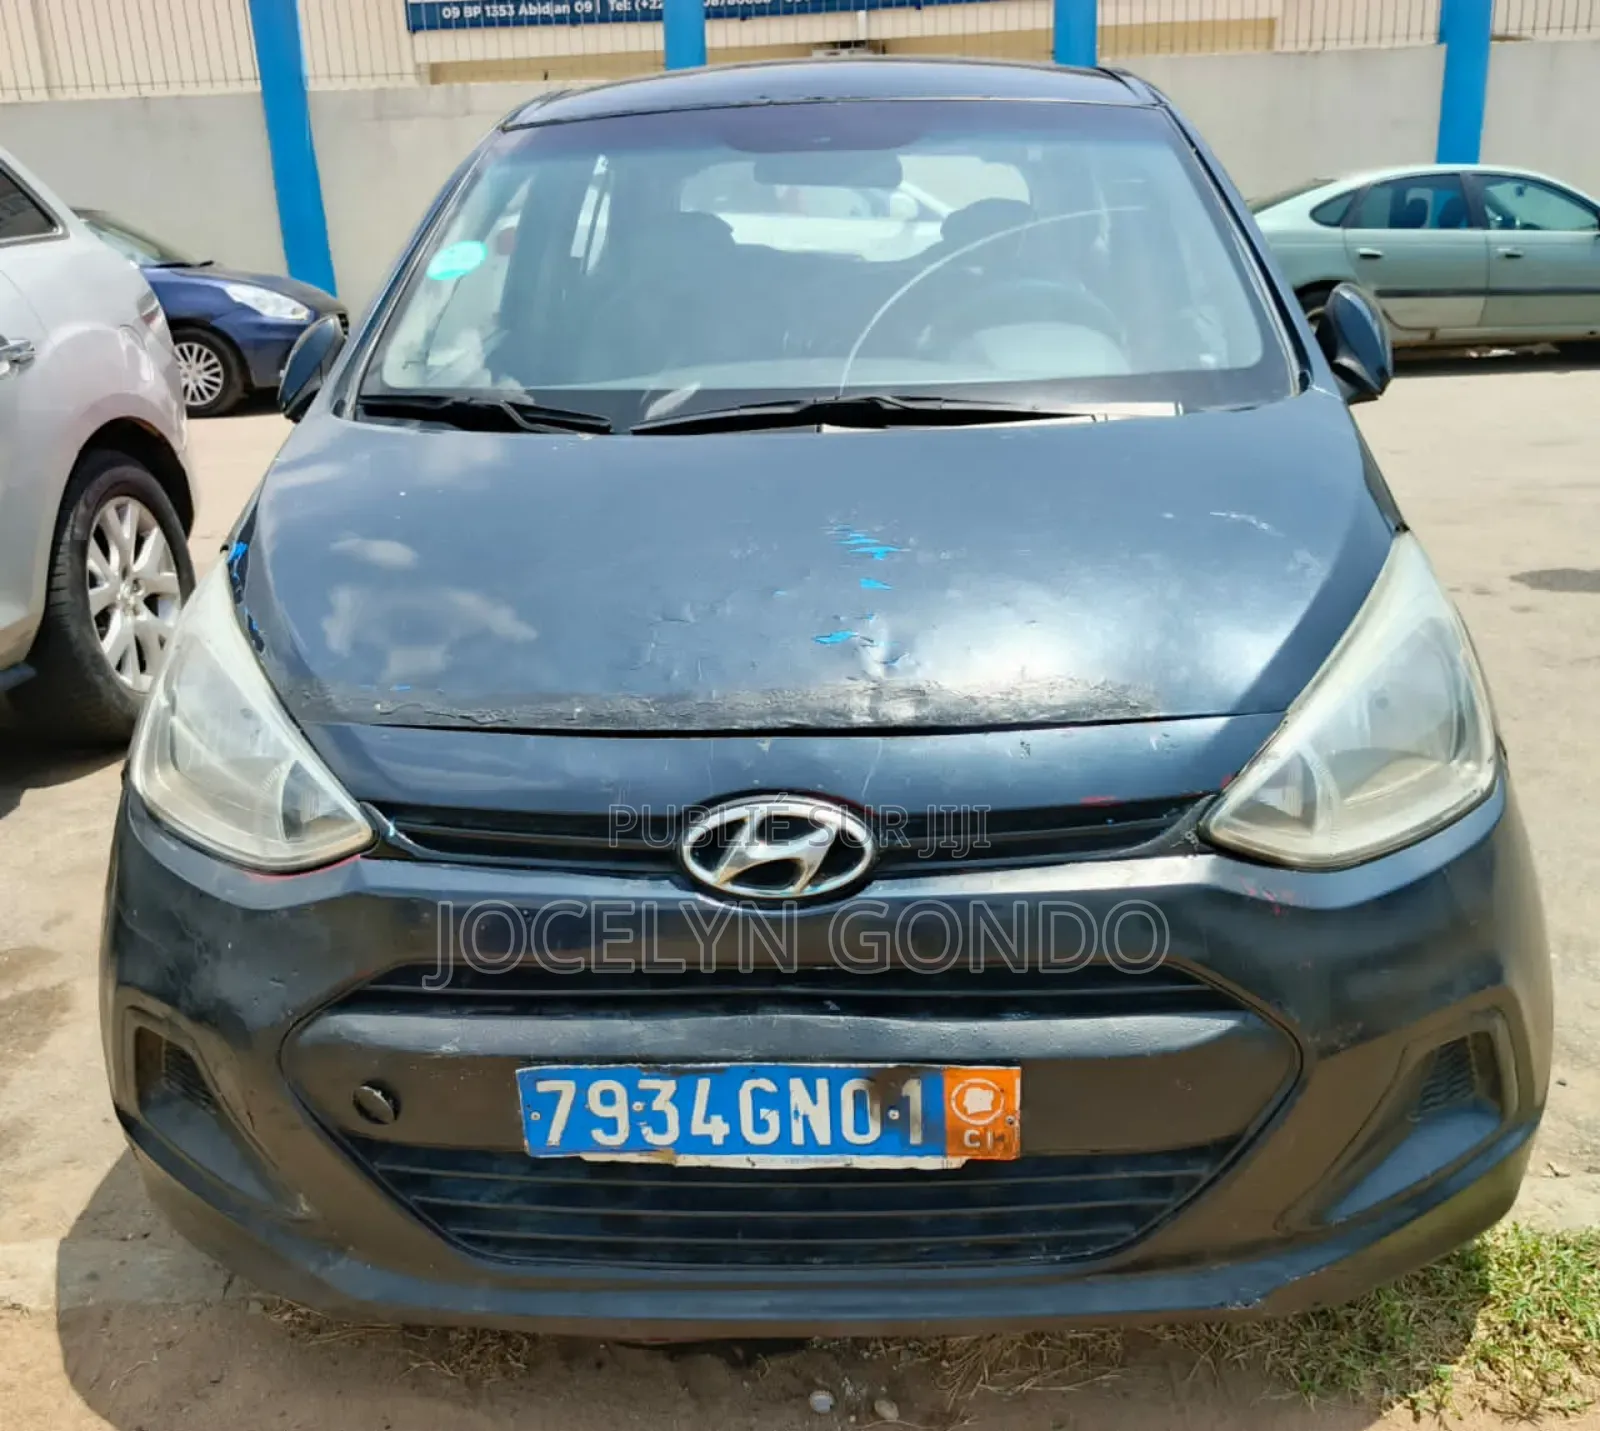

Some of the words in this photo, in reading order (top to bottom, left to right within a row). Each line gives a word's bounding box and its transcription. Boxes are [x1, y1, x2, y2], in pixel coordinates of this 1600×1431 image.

[441, 6, 461, 19] 09
[463, 5, 482, 18] BP
[484, 4, 515, 17] 1353
[518, 2, 570, 17] Abidjan
[574, 0, 593, 13] 09
